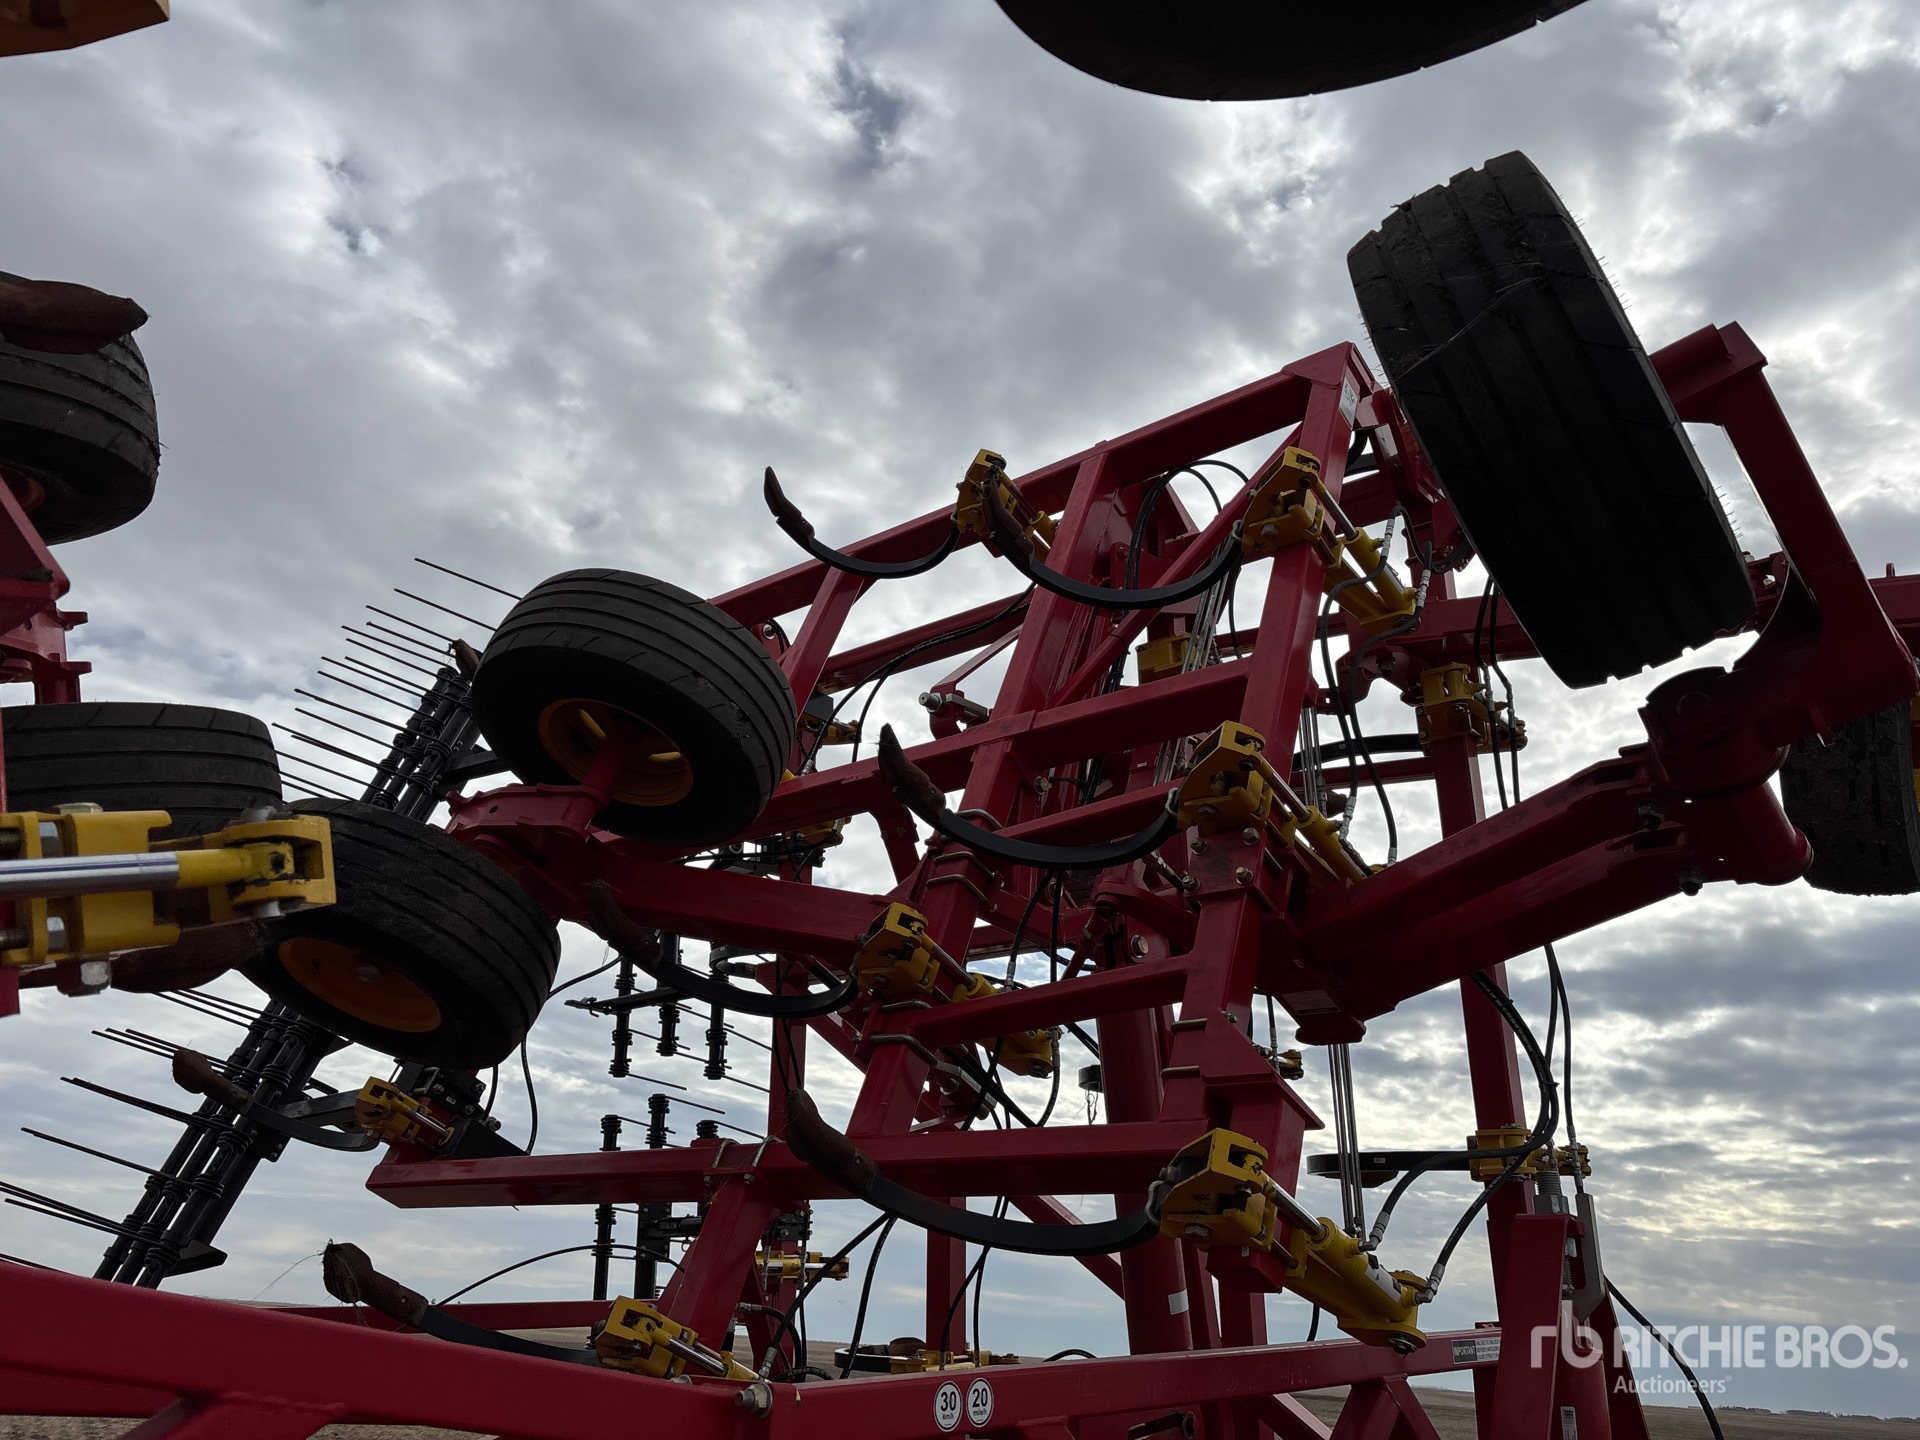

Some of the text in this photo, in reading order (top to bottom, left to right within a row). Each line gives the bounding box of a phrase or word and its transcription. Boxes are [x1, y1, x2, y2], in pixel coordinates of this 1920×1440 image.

[1453, 1345, 1475, 1356] IMPORTANT
[940, 1391, 957, 1411] 30
[972, 1387, 988, 1407] 20
